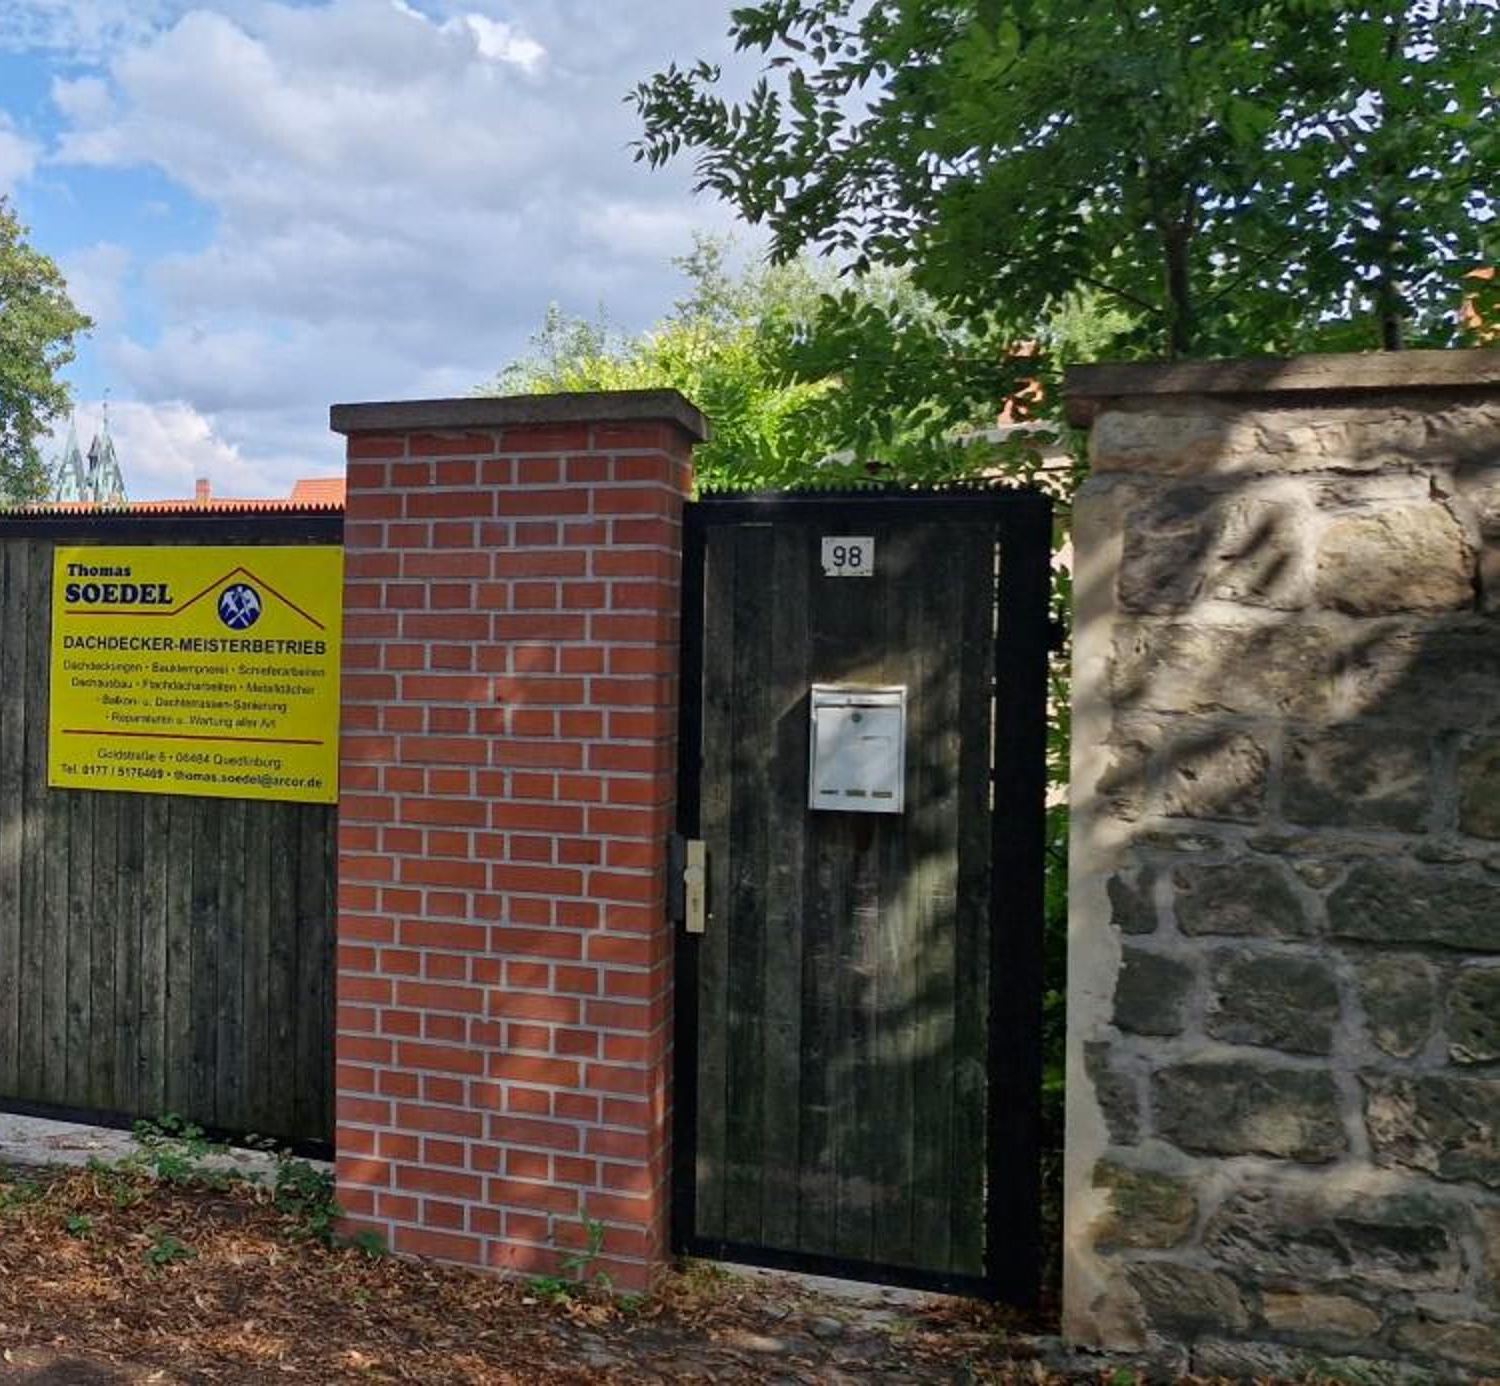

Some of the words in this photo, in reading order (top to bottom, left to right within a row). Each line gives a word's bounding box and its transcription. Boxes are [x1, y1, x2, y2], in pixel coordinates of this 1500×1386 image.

[833, 546, 862, 567] 98
[67, 564, 131, 577] Thomas
[65, 583, 173, 604] SOEDEL
[63, 636, 325, 655] DACHDECKER-MEISTERBETRIEB
[64, 660, 142, 673] Dachdeckungen
[238, 665, 324, 677] Schieferarbeiten
[72, 677, 132, 688] Dachausbau
[213, 754, 281, 769] Quedlinburg
[81, 765, 108, 776] 0177
[174, 770, 323, 788] thomas.soedel@arcor.de
